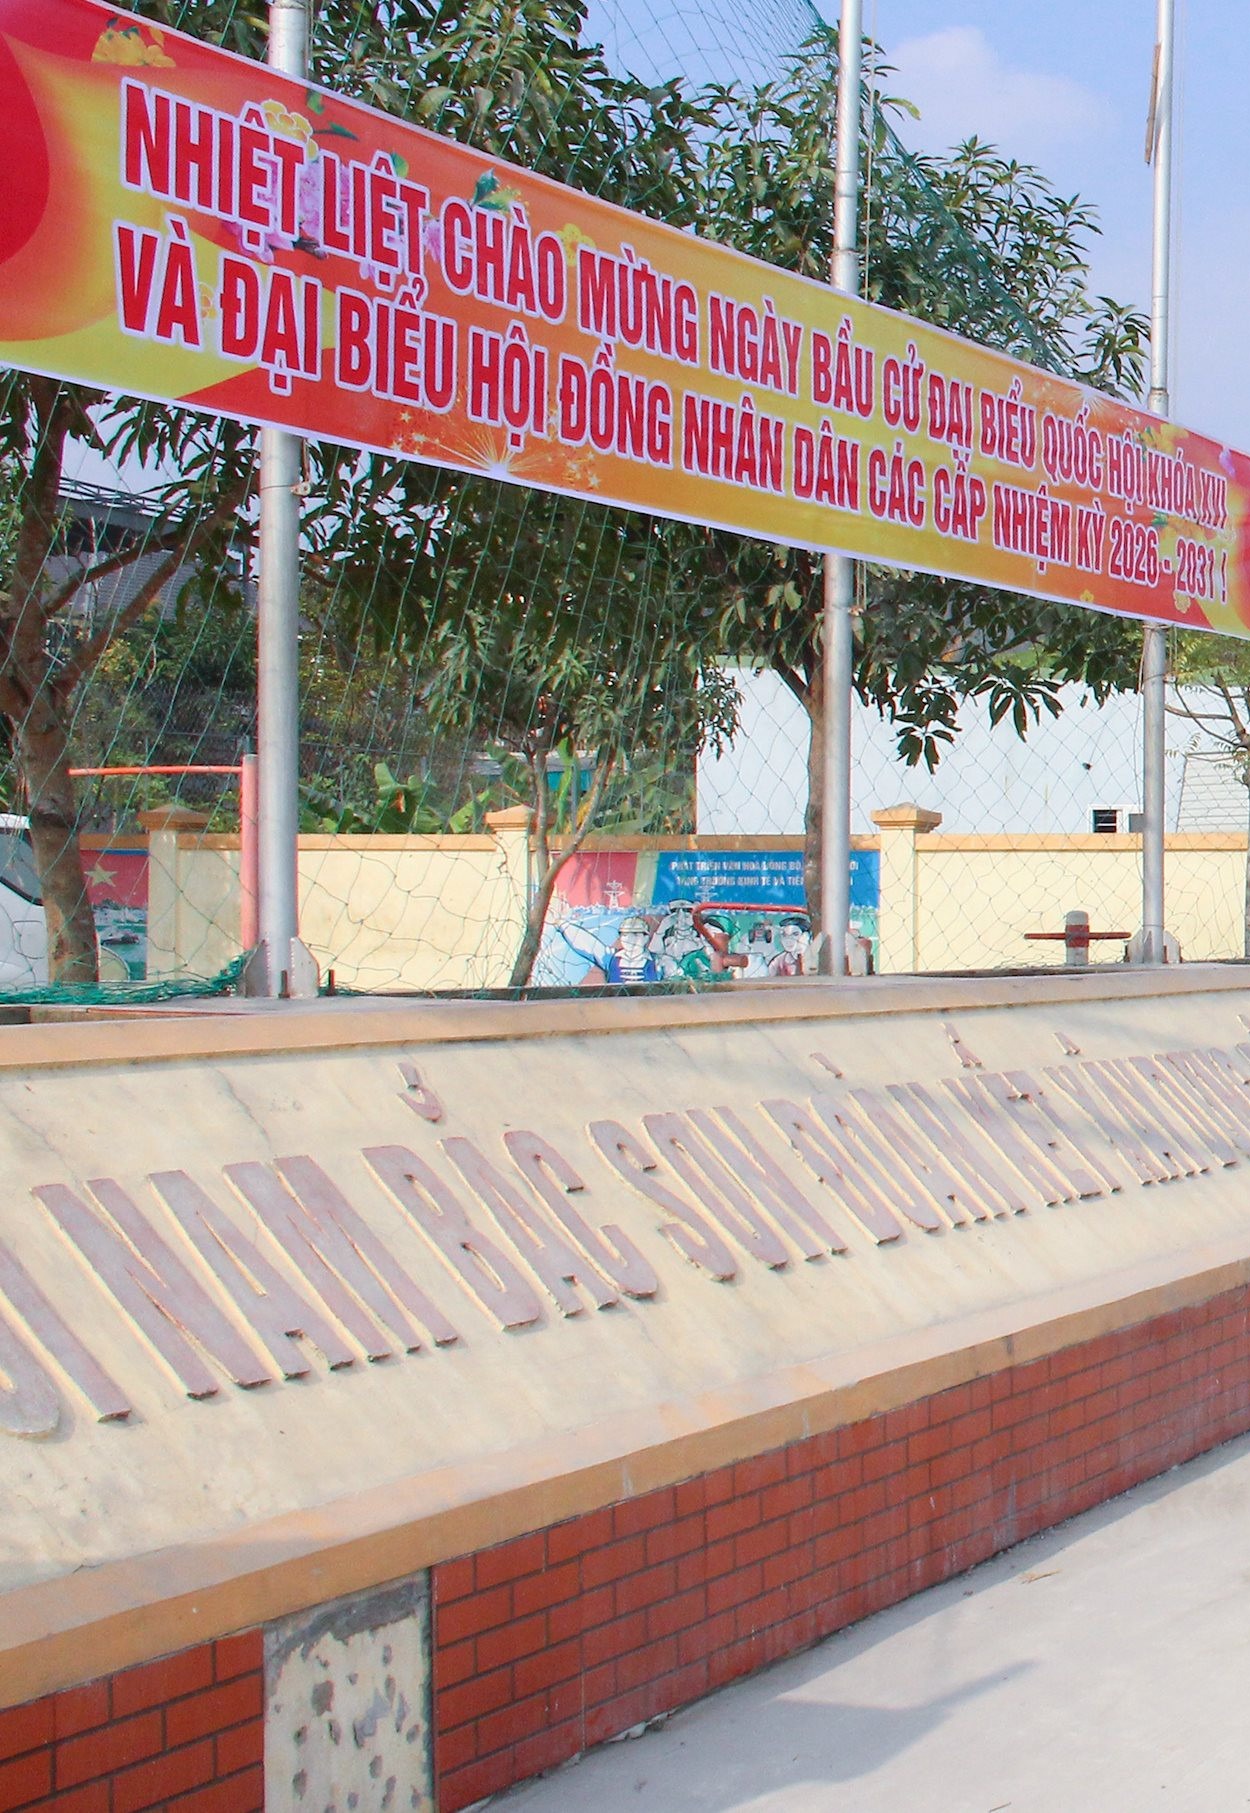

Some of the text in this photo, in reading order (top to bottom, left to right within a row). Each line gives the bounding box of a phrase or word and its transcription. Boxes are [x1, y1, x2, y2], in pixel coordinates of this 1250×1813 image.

[117, 218, 1227, 602] VÀ ĐẠI BIỂU HỘI ĐỒNG NHÂN DÂN CÁC CẤP NHIỆM KỲ 2026 - 2031 !
[125, 82, 1228, 530] NHIỆT LIỆT CHÀO MỪNG NGÀY BẦU CỬ ĐẠI BIỂU QUỐC HỘI KHÓA XVI
[29, 1155, 460, 1399] NAM
[360, 1061, 660, 1332] BẮC
